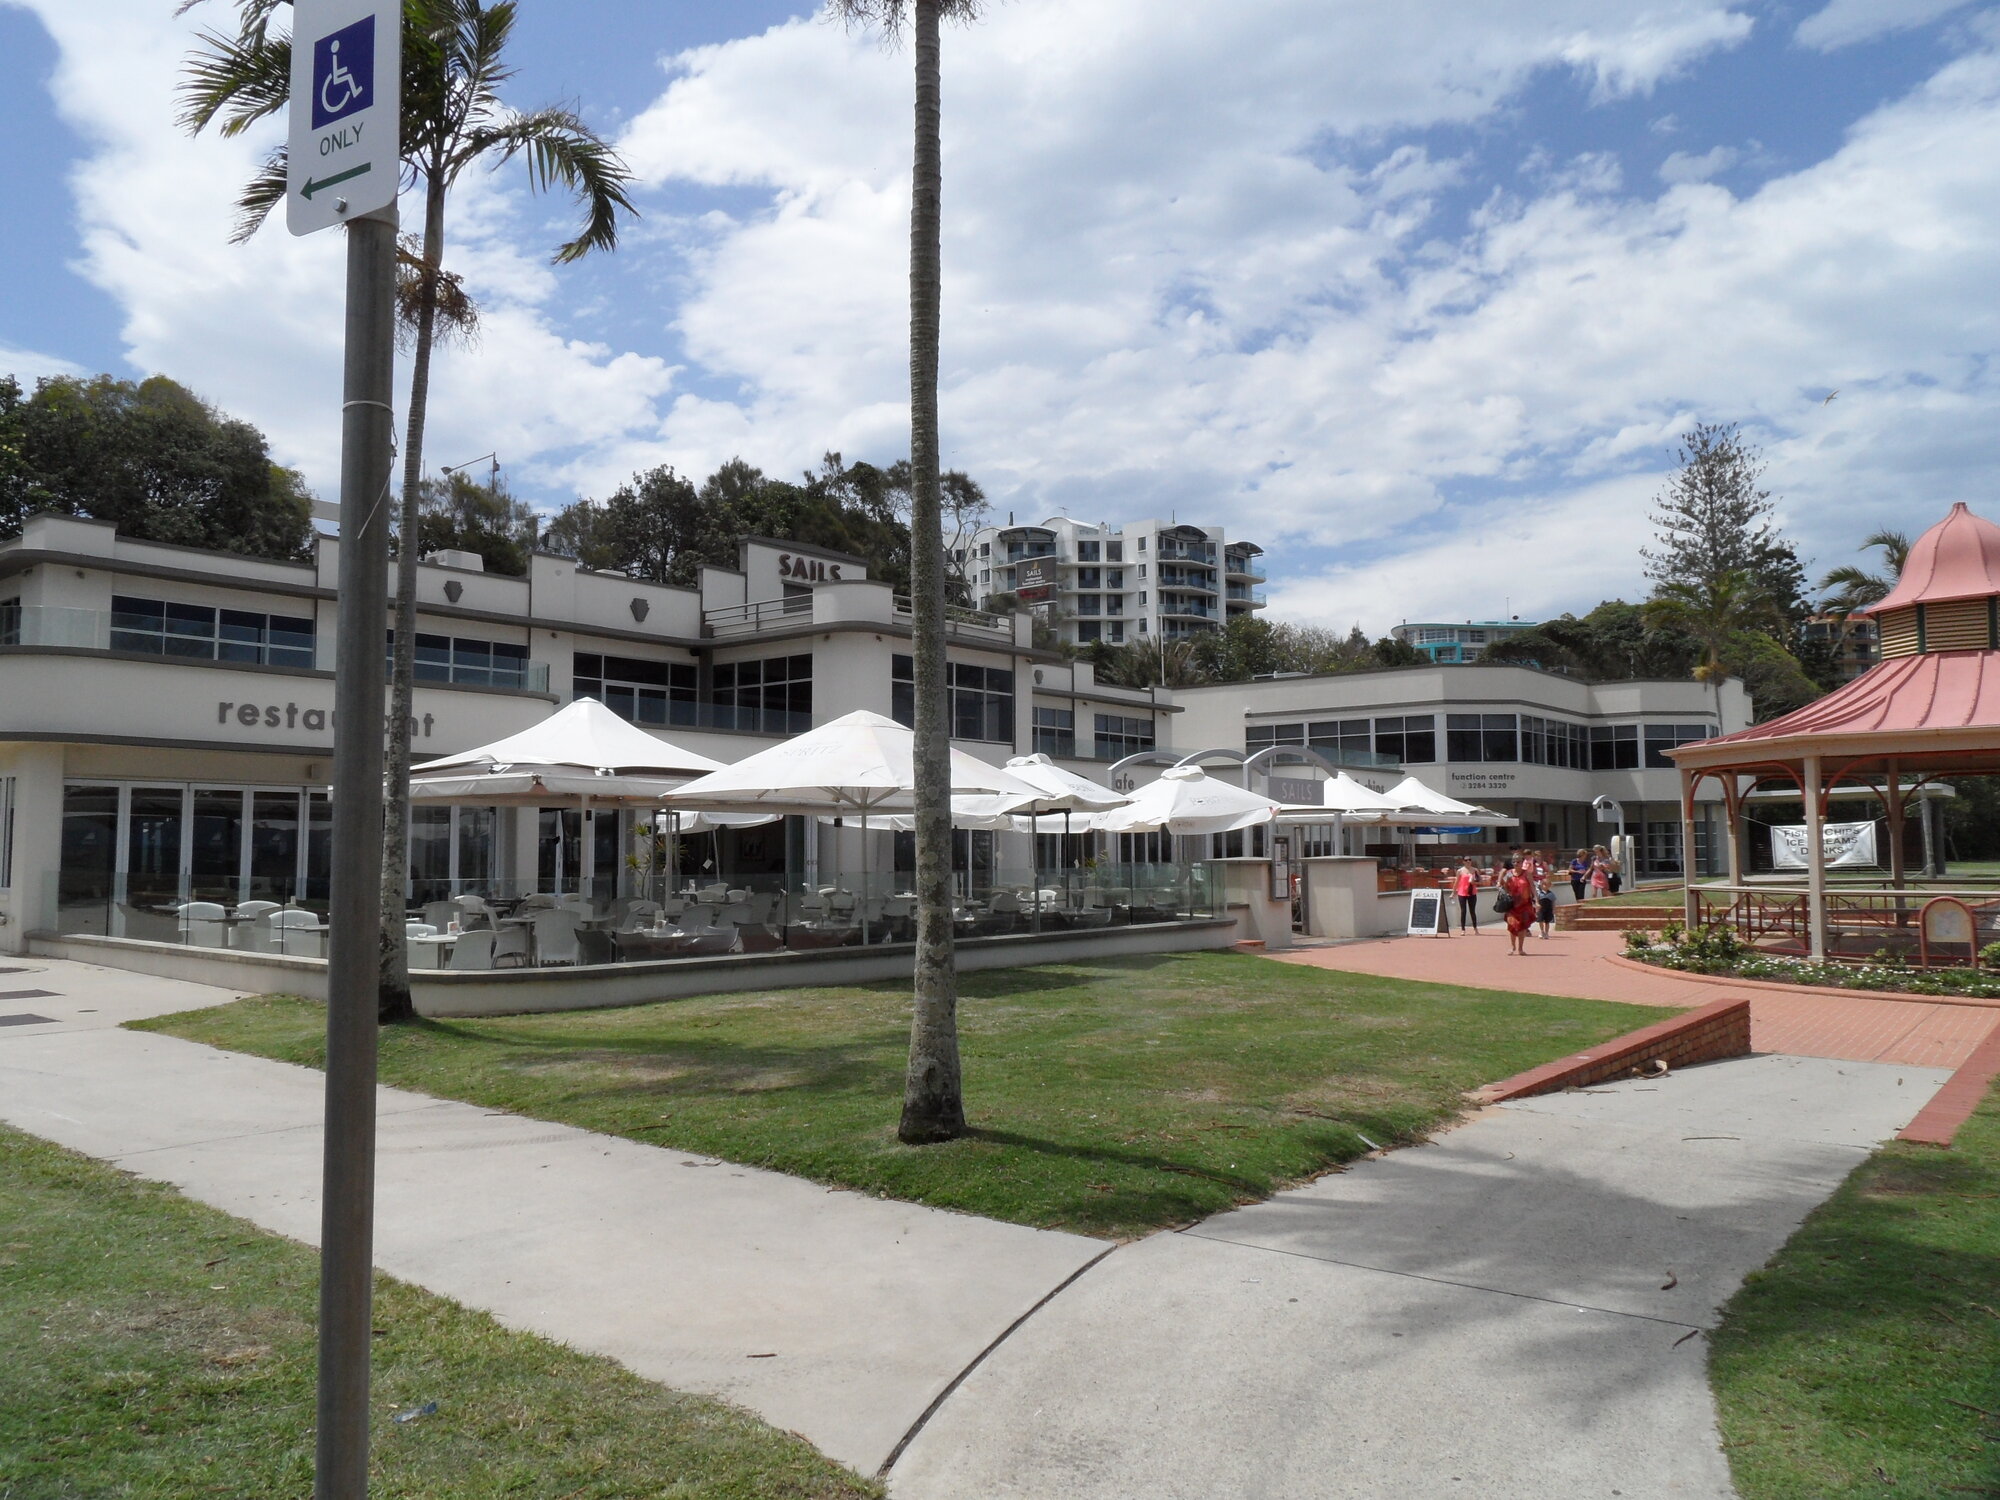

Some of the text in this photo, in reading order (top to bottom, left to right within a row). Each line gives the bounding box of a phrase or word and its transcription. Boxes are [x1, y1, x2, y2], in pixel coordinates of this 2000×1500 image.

[320, 122, 364, 156] ONLY
[1026, 568, 1042, 577] SAILS
[218, 701, 435, 737] restat
[1115, 773, 1135, 790] afe
[1452, 772, 1486, 780] function
[1281, 782, 1313, 800] SAILS
[1824, 828, 1860, 836] CHIPS
[1786, 836, 1858, 847] ICE EAMS
[1801, 846, 1844, 855] DNKS
